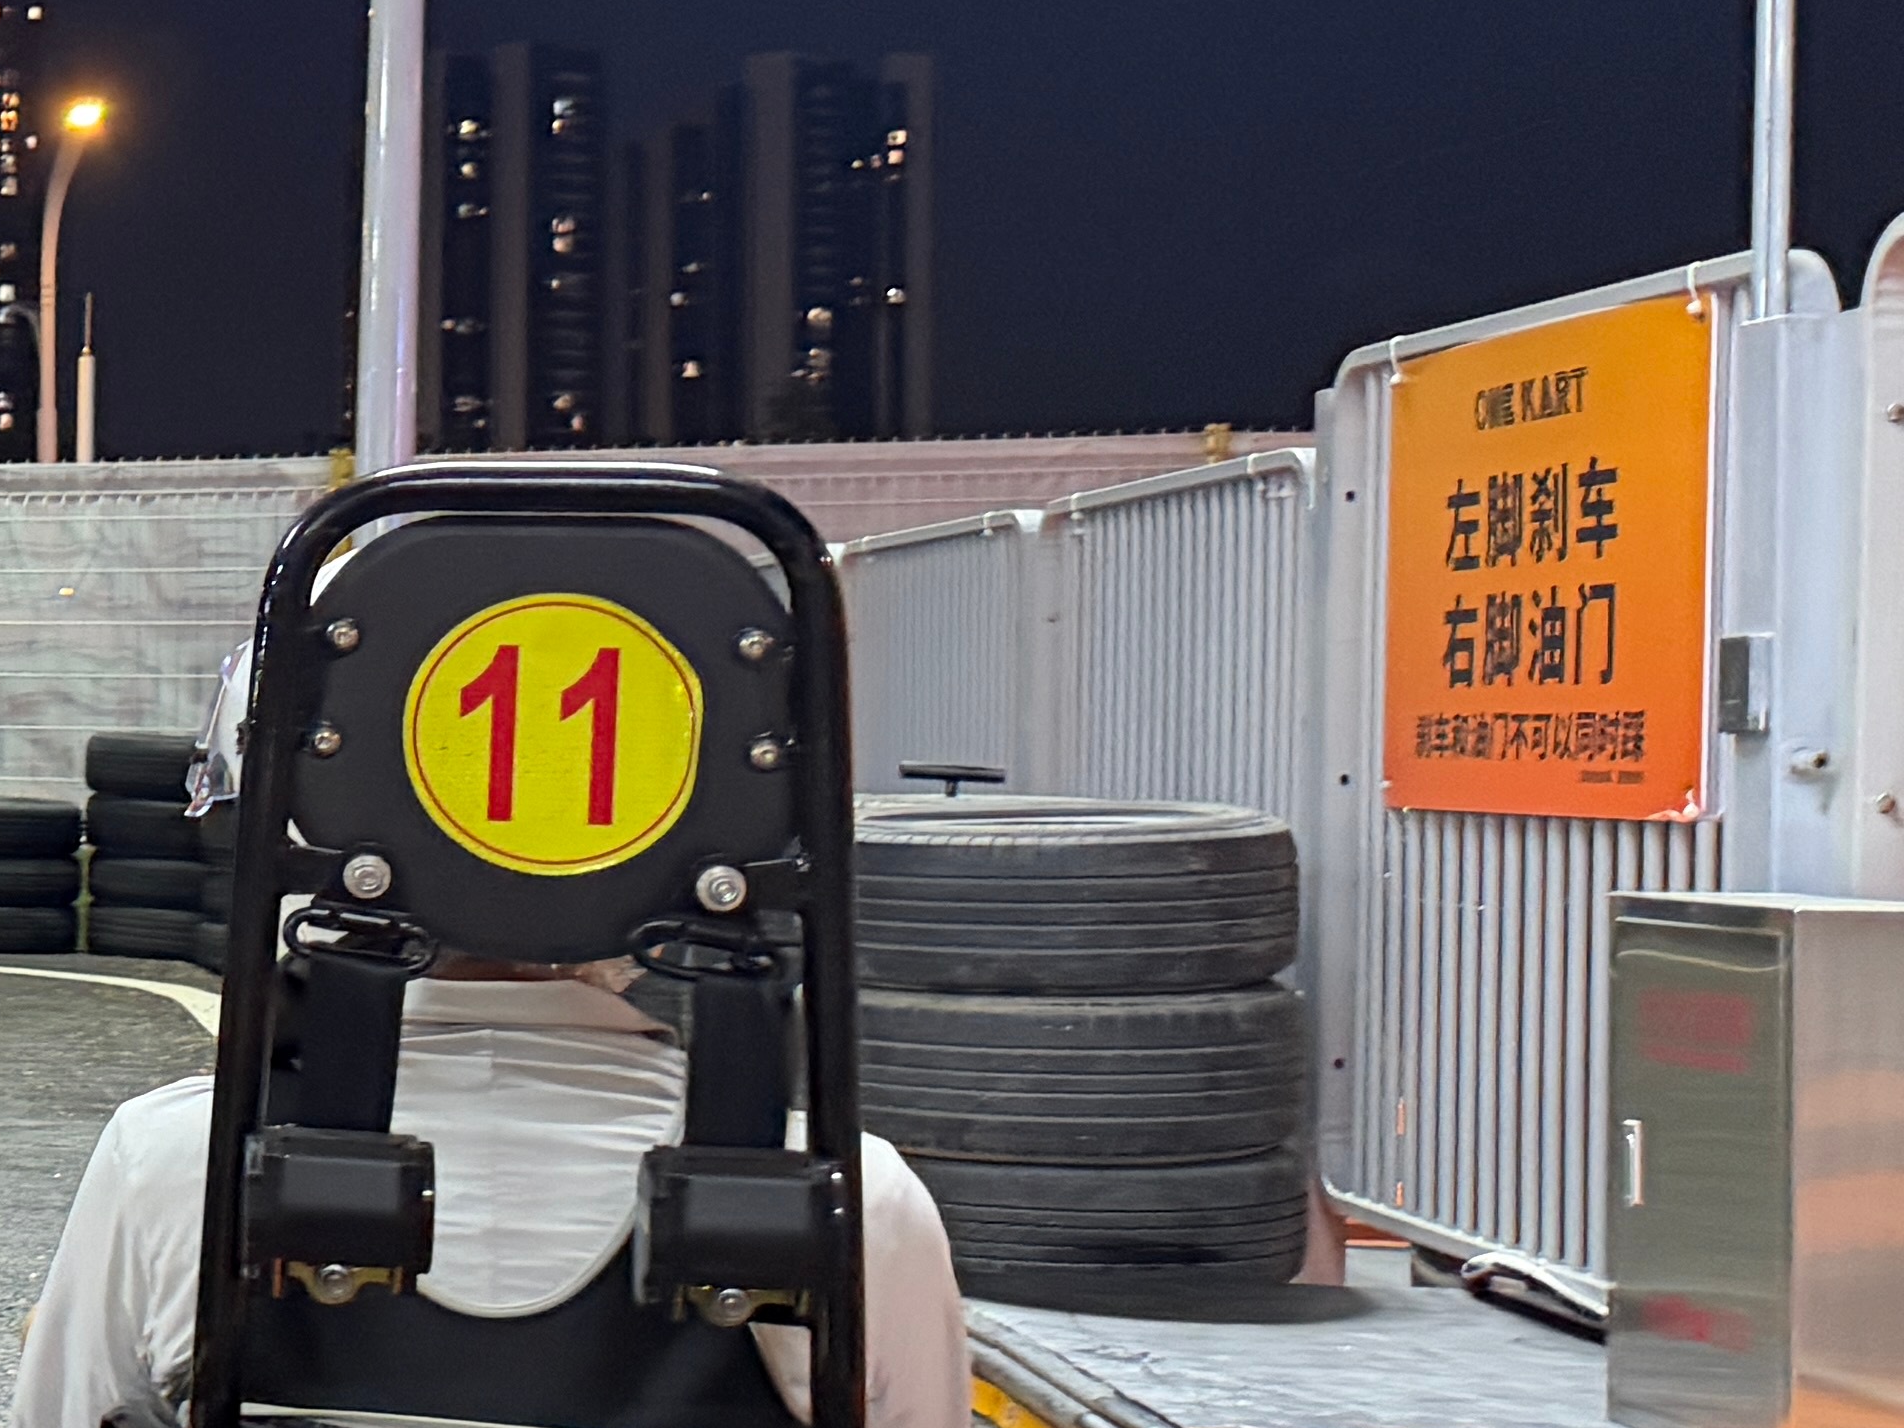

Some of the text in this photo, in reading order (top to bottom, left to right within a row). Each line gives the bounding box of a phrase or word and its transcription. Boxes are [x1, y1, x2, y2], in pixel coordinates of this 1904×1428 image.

[1474, 366, 1590, 431] ONE KART
[1444, 456, 1620, 573] 左脚刹车
[1441, 581, 1618, 688] 右脚油门
[458, 644, 621, 827] 11
